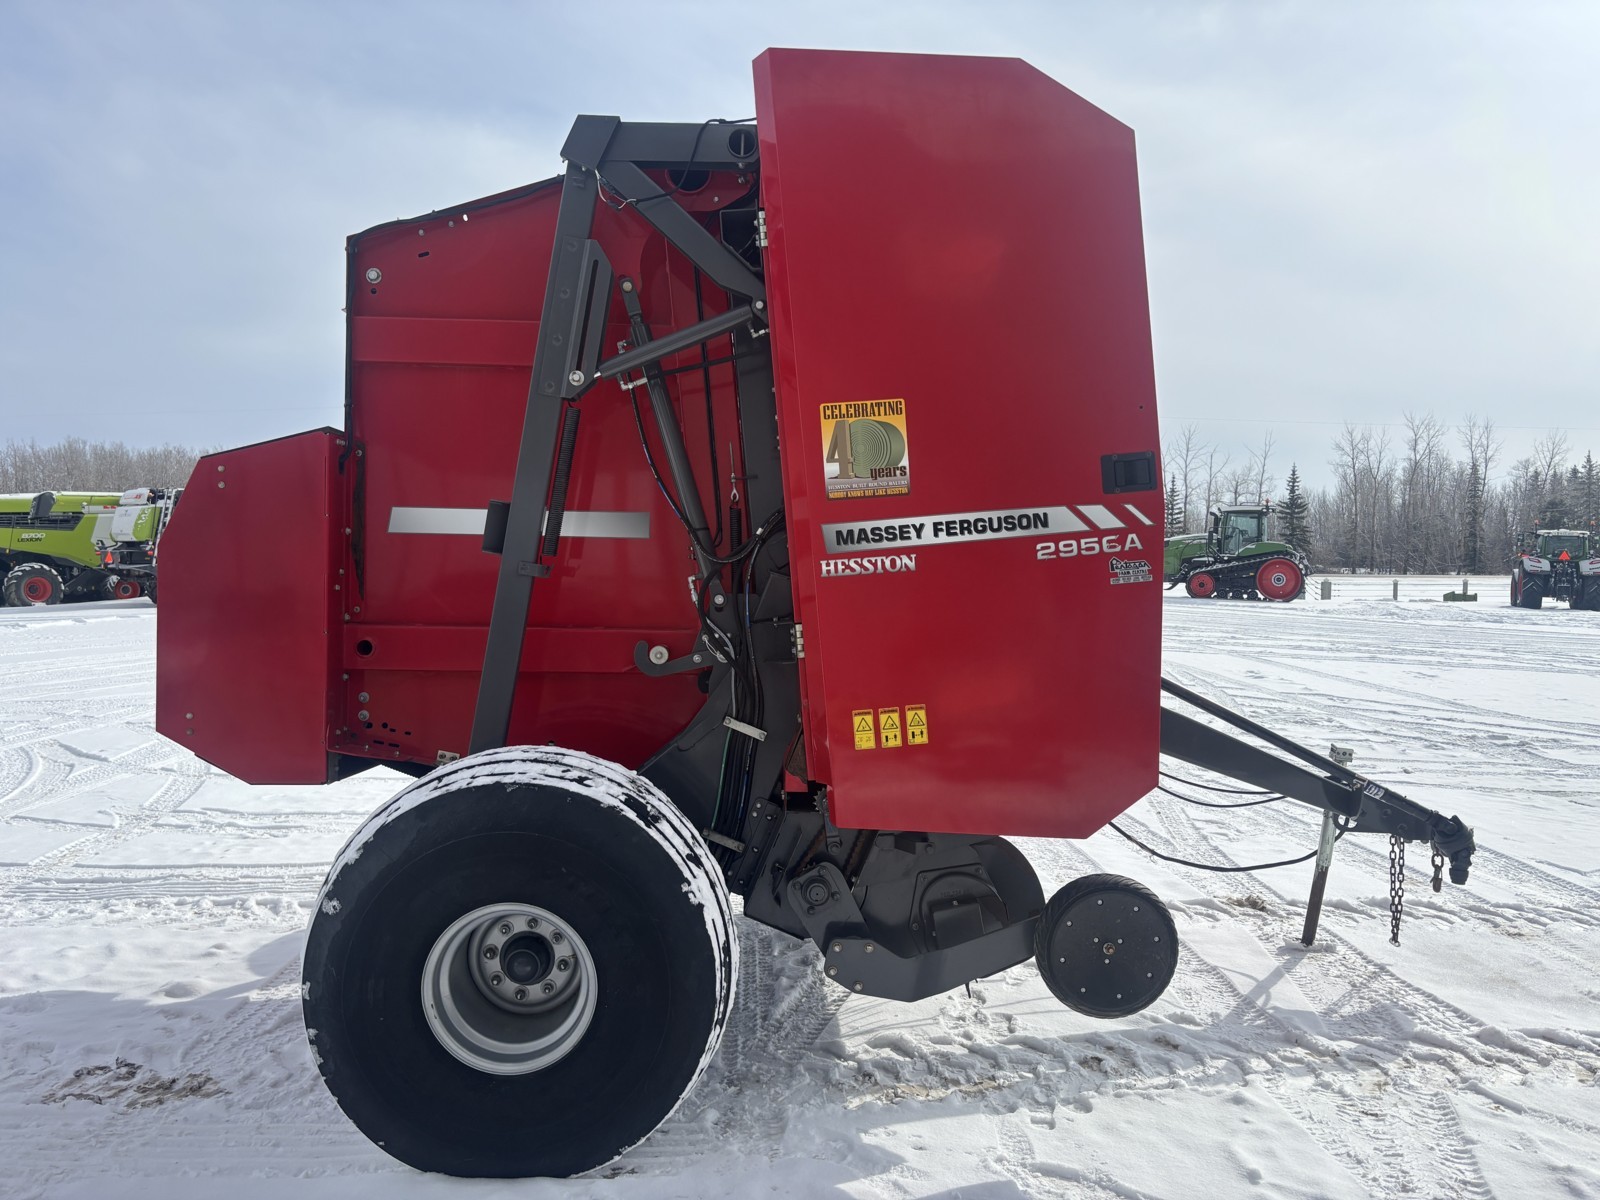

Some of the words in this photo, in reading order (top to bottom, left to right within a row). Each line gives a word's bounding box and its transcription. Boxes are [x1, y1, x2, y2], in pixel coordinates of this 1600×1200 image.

[822, 400, 903, 420] CELEBRATING
[869, 465, 907, 480] years
[847, 489, 864, 498] KNOWS
[865, 488, 874, 497] HAY
[874, 488, 887, 496] LIKE
[887, 487, 909, 495] HESSTON
[835, 522, 925, 546] MASSEY
[932, 512, 1050, 538] FERGUSON
[1035, 533, 1144, 560] 2956A
[820, 554, 917, 577] HESSTON
